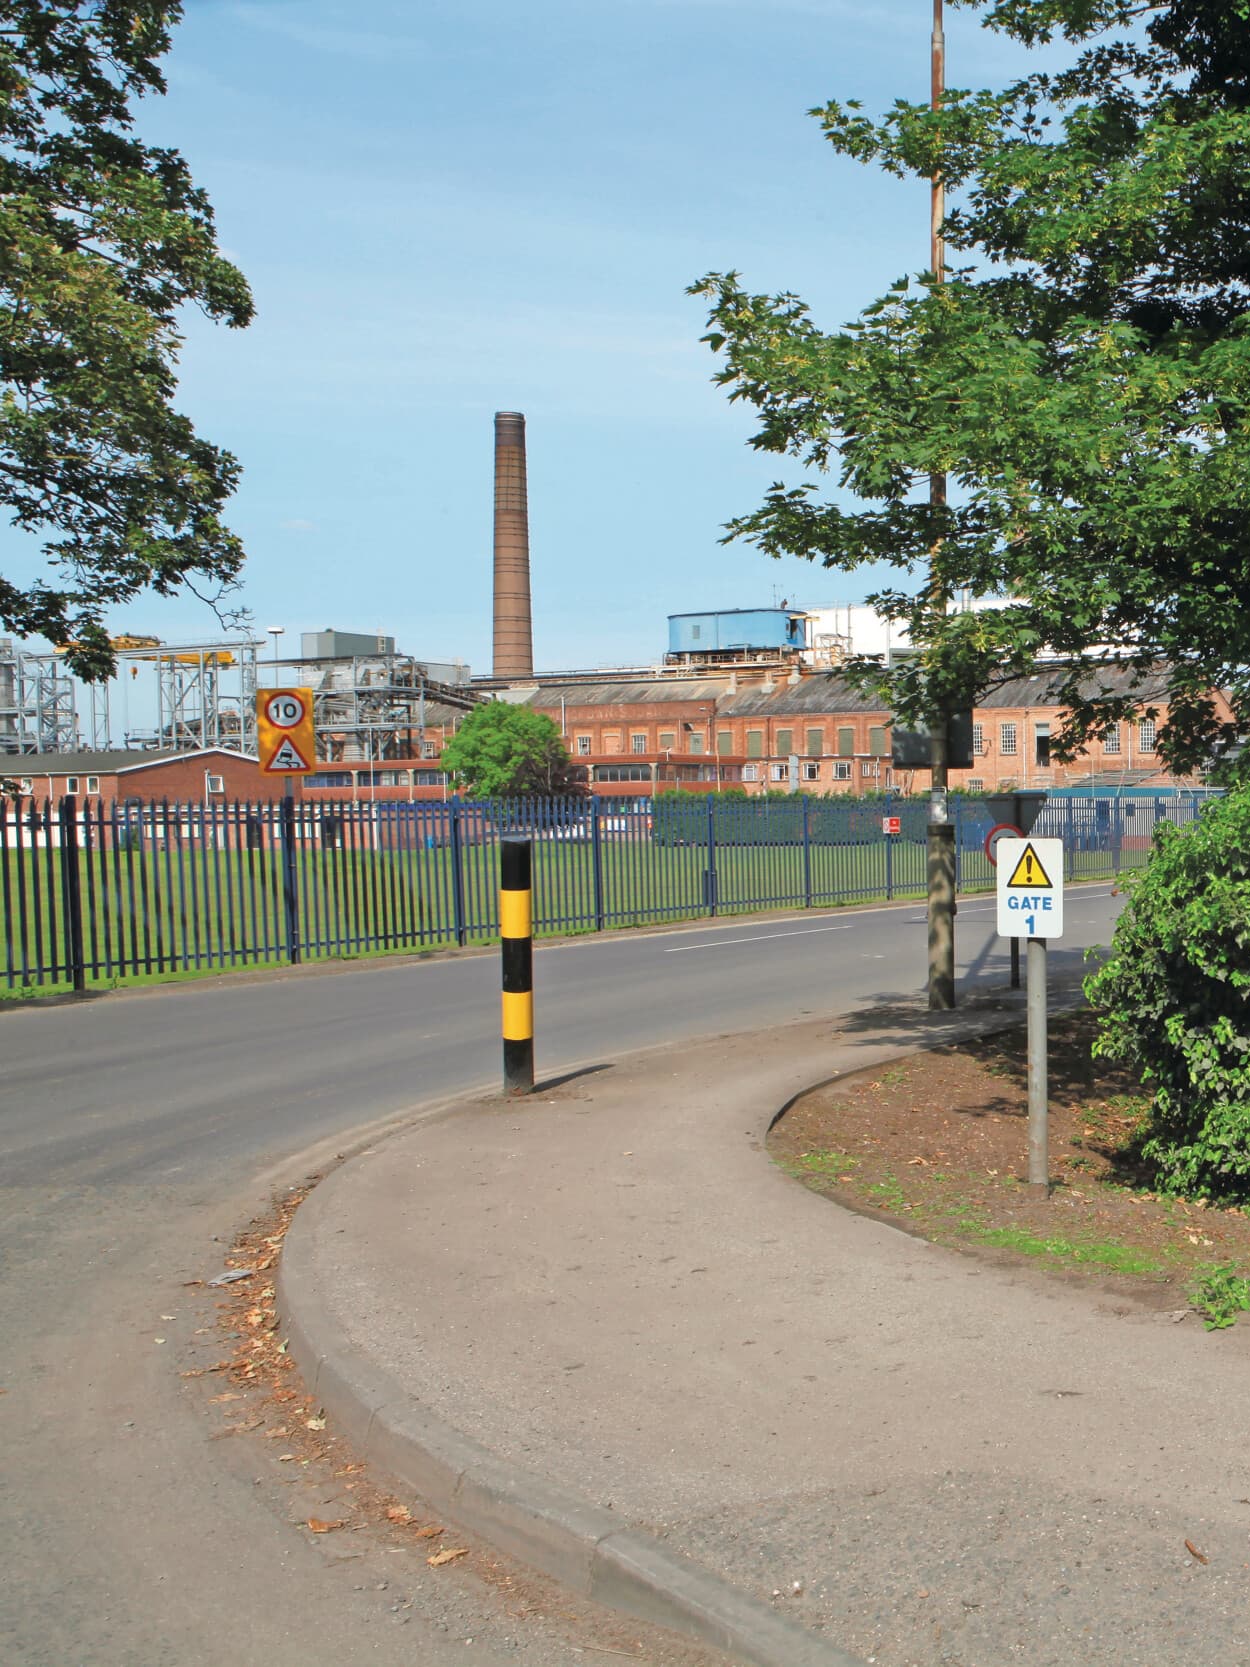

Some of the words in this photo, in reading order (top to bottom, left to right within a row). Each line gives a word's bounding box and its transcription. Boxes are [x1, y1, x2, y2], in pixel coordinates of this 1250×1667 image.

[273, 703, 297, 719] 10
[1007, 895, 1053, 911] GATE
[1024, 914, 1035, 935] 1
